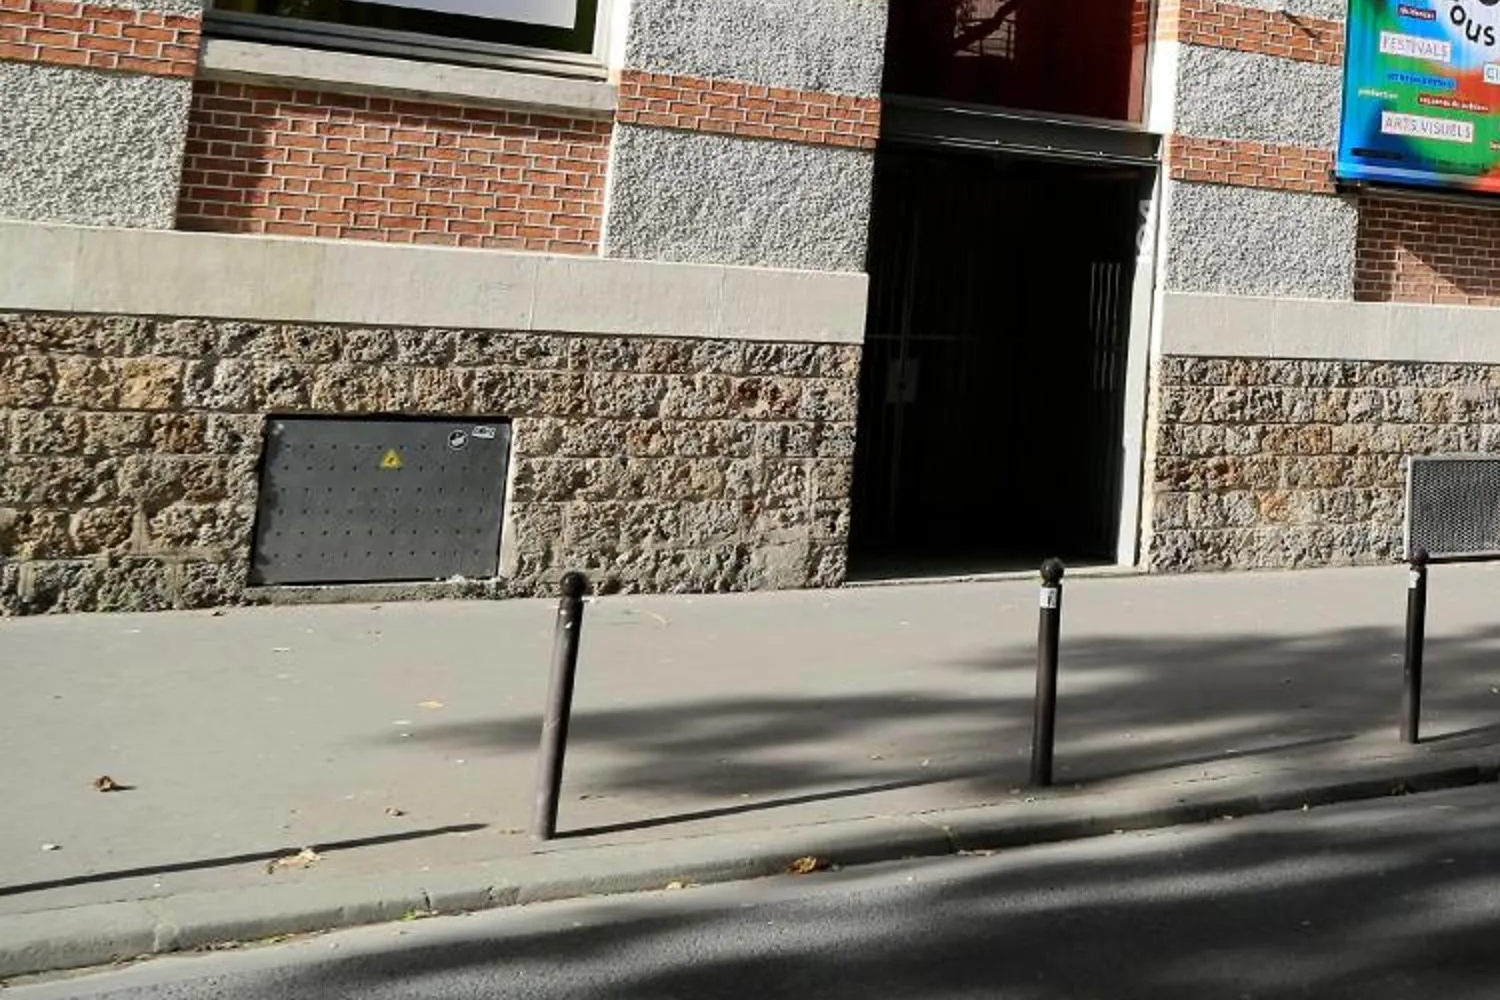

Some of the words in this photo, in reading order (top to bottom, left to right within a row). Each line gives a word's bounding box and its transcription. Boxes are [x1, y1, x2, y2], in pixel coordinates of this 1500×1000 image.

[1383, 35, 1448, 57] FESTIVALS
[1385, 116, 1417, 133] ARTS
[1421, 119, 1471, 139] VISUELS
